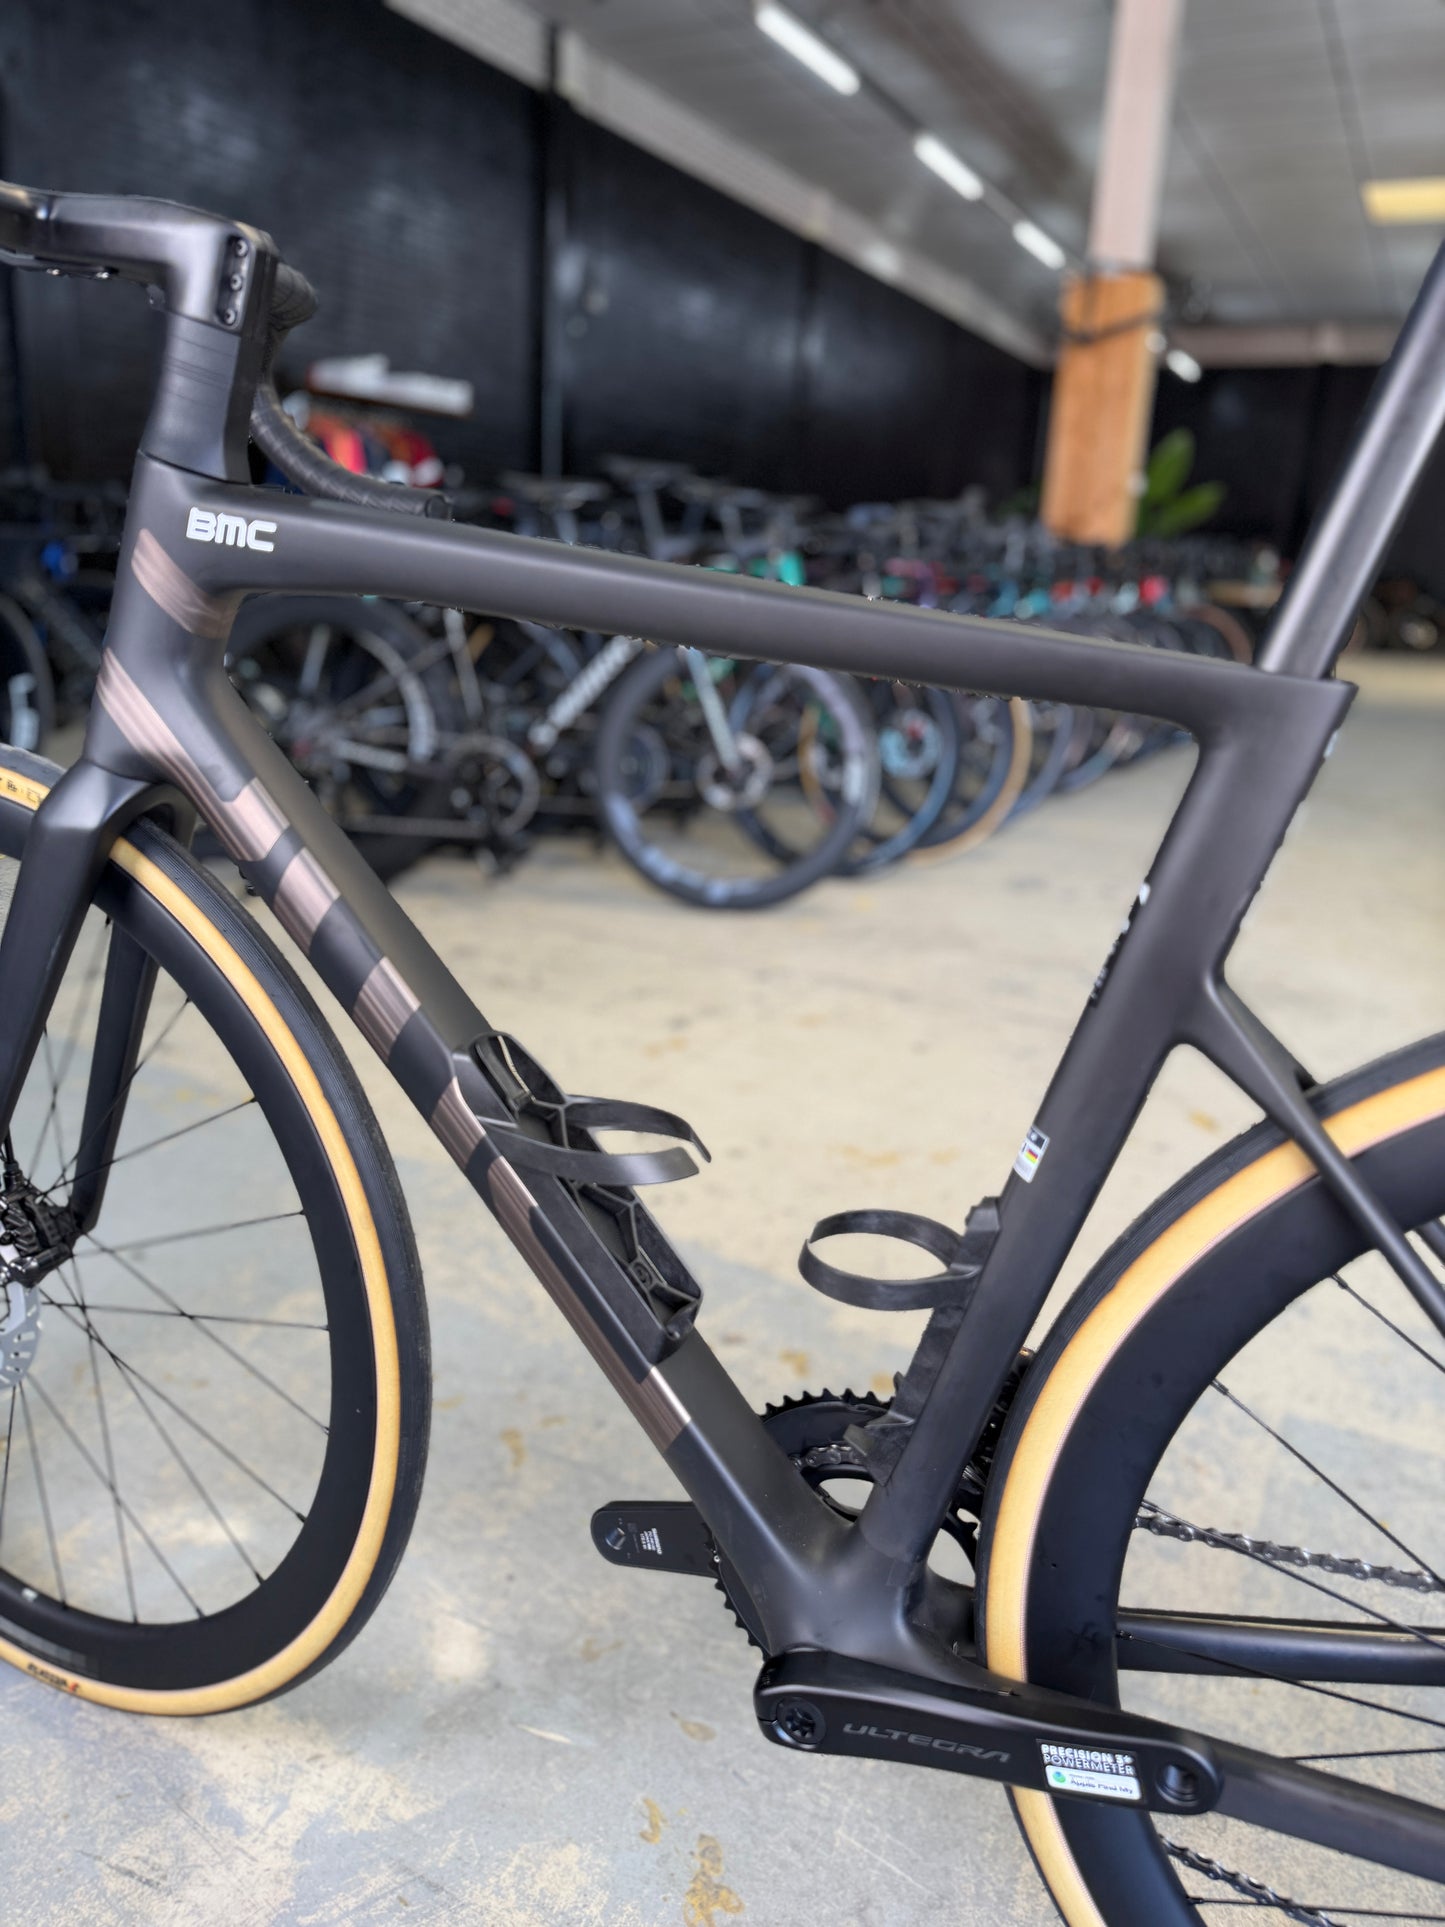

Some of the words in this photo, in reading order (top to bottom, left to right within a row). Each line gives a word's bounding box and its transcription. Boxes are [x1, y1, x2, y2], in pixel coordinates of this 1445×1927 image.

[186, 507, 277, 552] BMC
[843, 1723, 1010, 1763] ULTEGRA
[1041, 1744, 1113, 1763] PRECISION
[1043, 1753, 1136, 1775] POWERMETER
